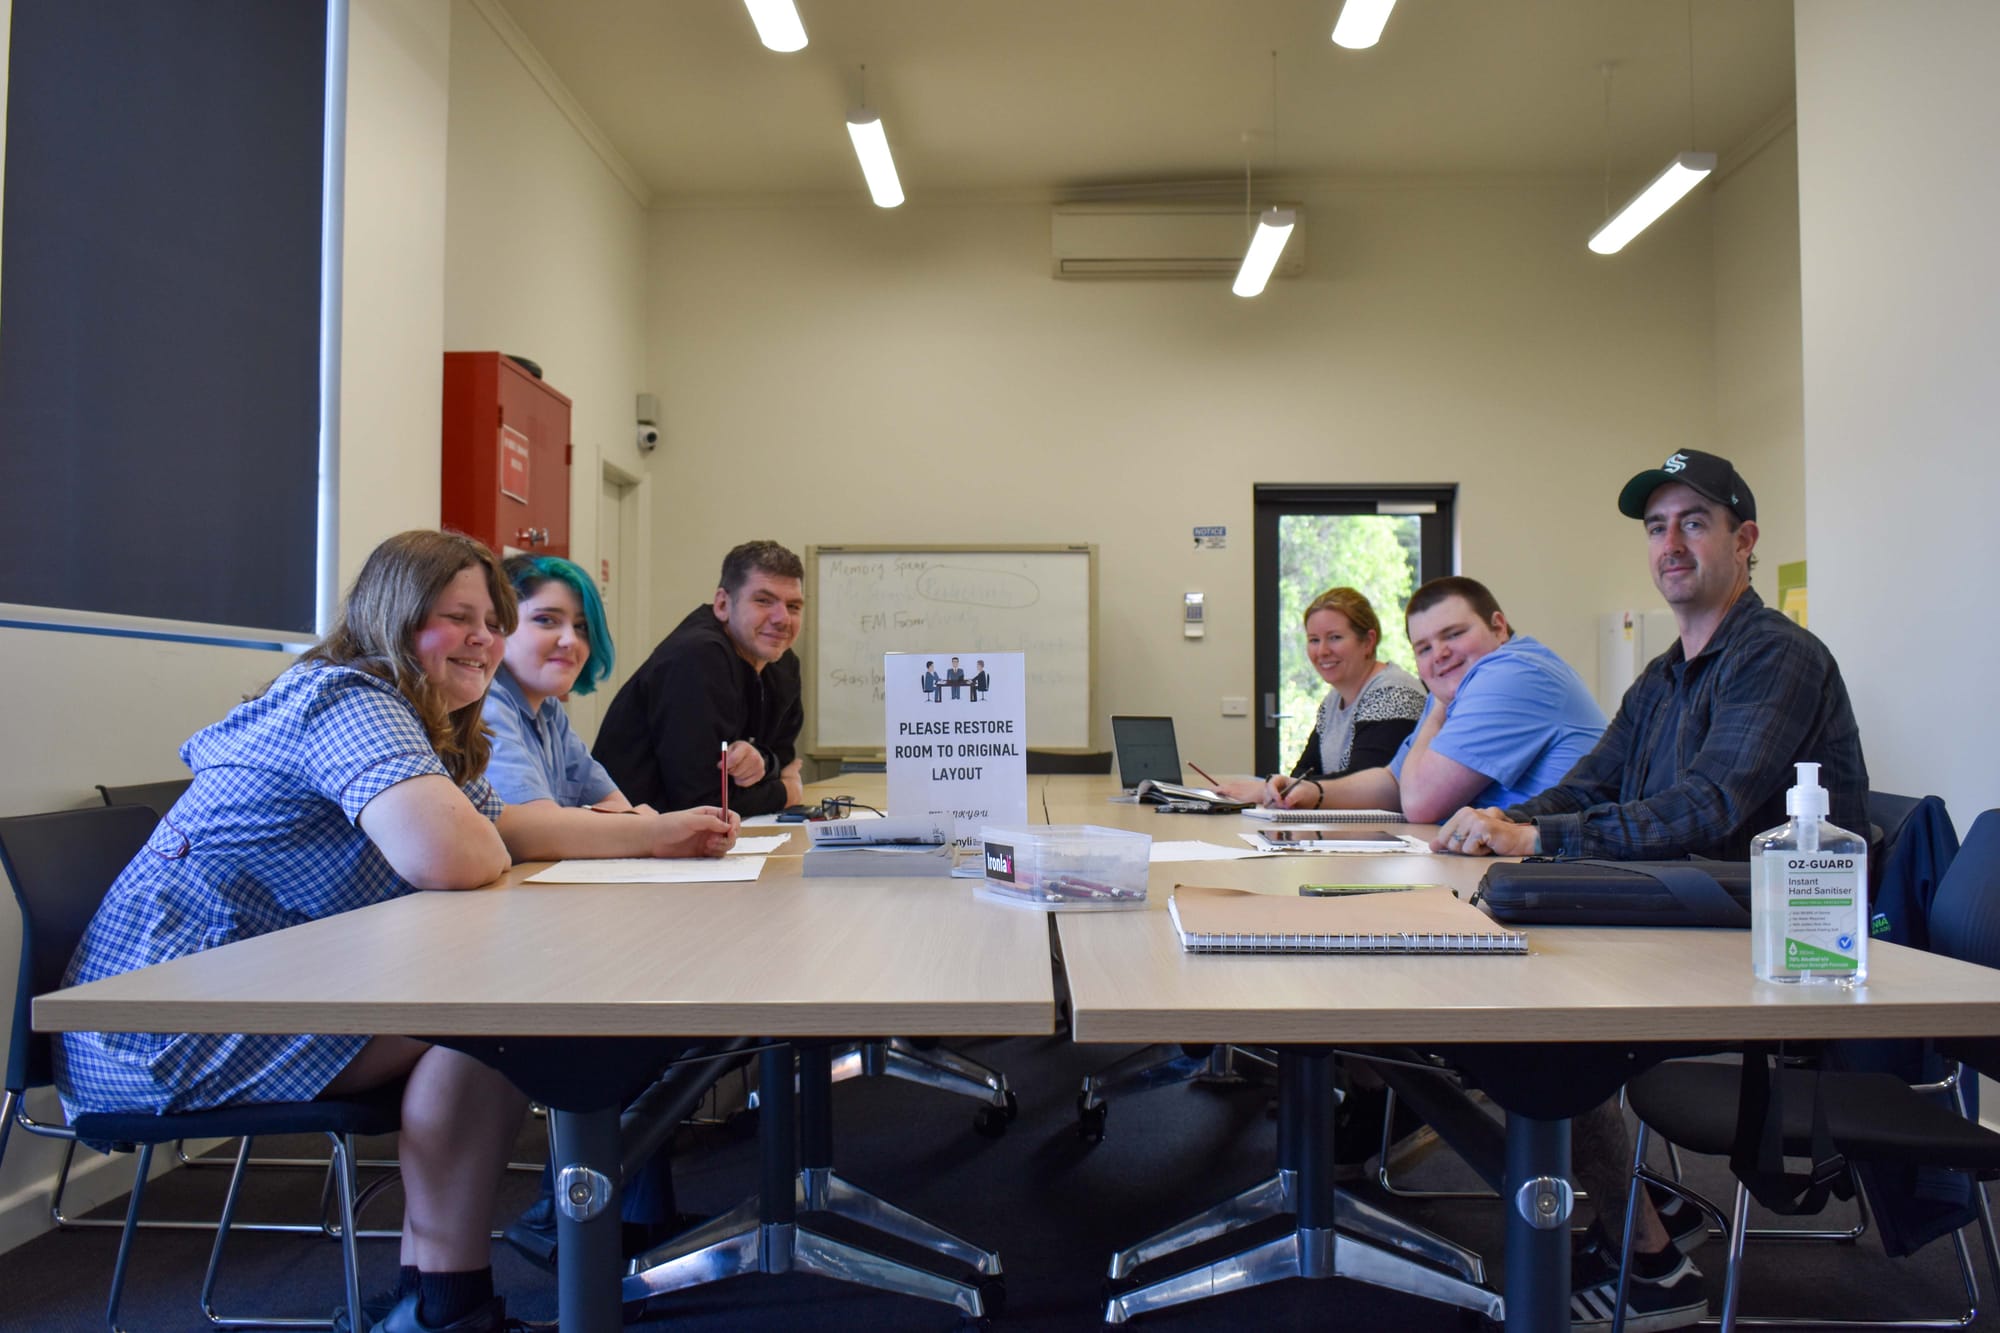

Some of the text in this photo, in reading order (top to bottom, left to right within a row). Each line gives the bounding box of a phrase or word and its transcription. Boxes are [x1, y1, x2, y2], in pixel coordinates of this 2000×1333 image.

[1194, 527, 1226, 536] NOTICE
[900, 720, 1014, 735] PLEASE RESTORE
[895, 743, 1019, 759] ROOM TO ORIGINAL
[932, 767, 983, 781] LAYOUT
[1788, 859, 1854, 869] OZ-GUARD
[1788, 878, 1819, 886] Instant
[1788, 887, 1852, 895] Hand Sanitiser
